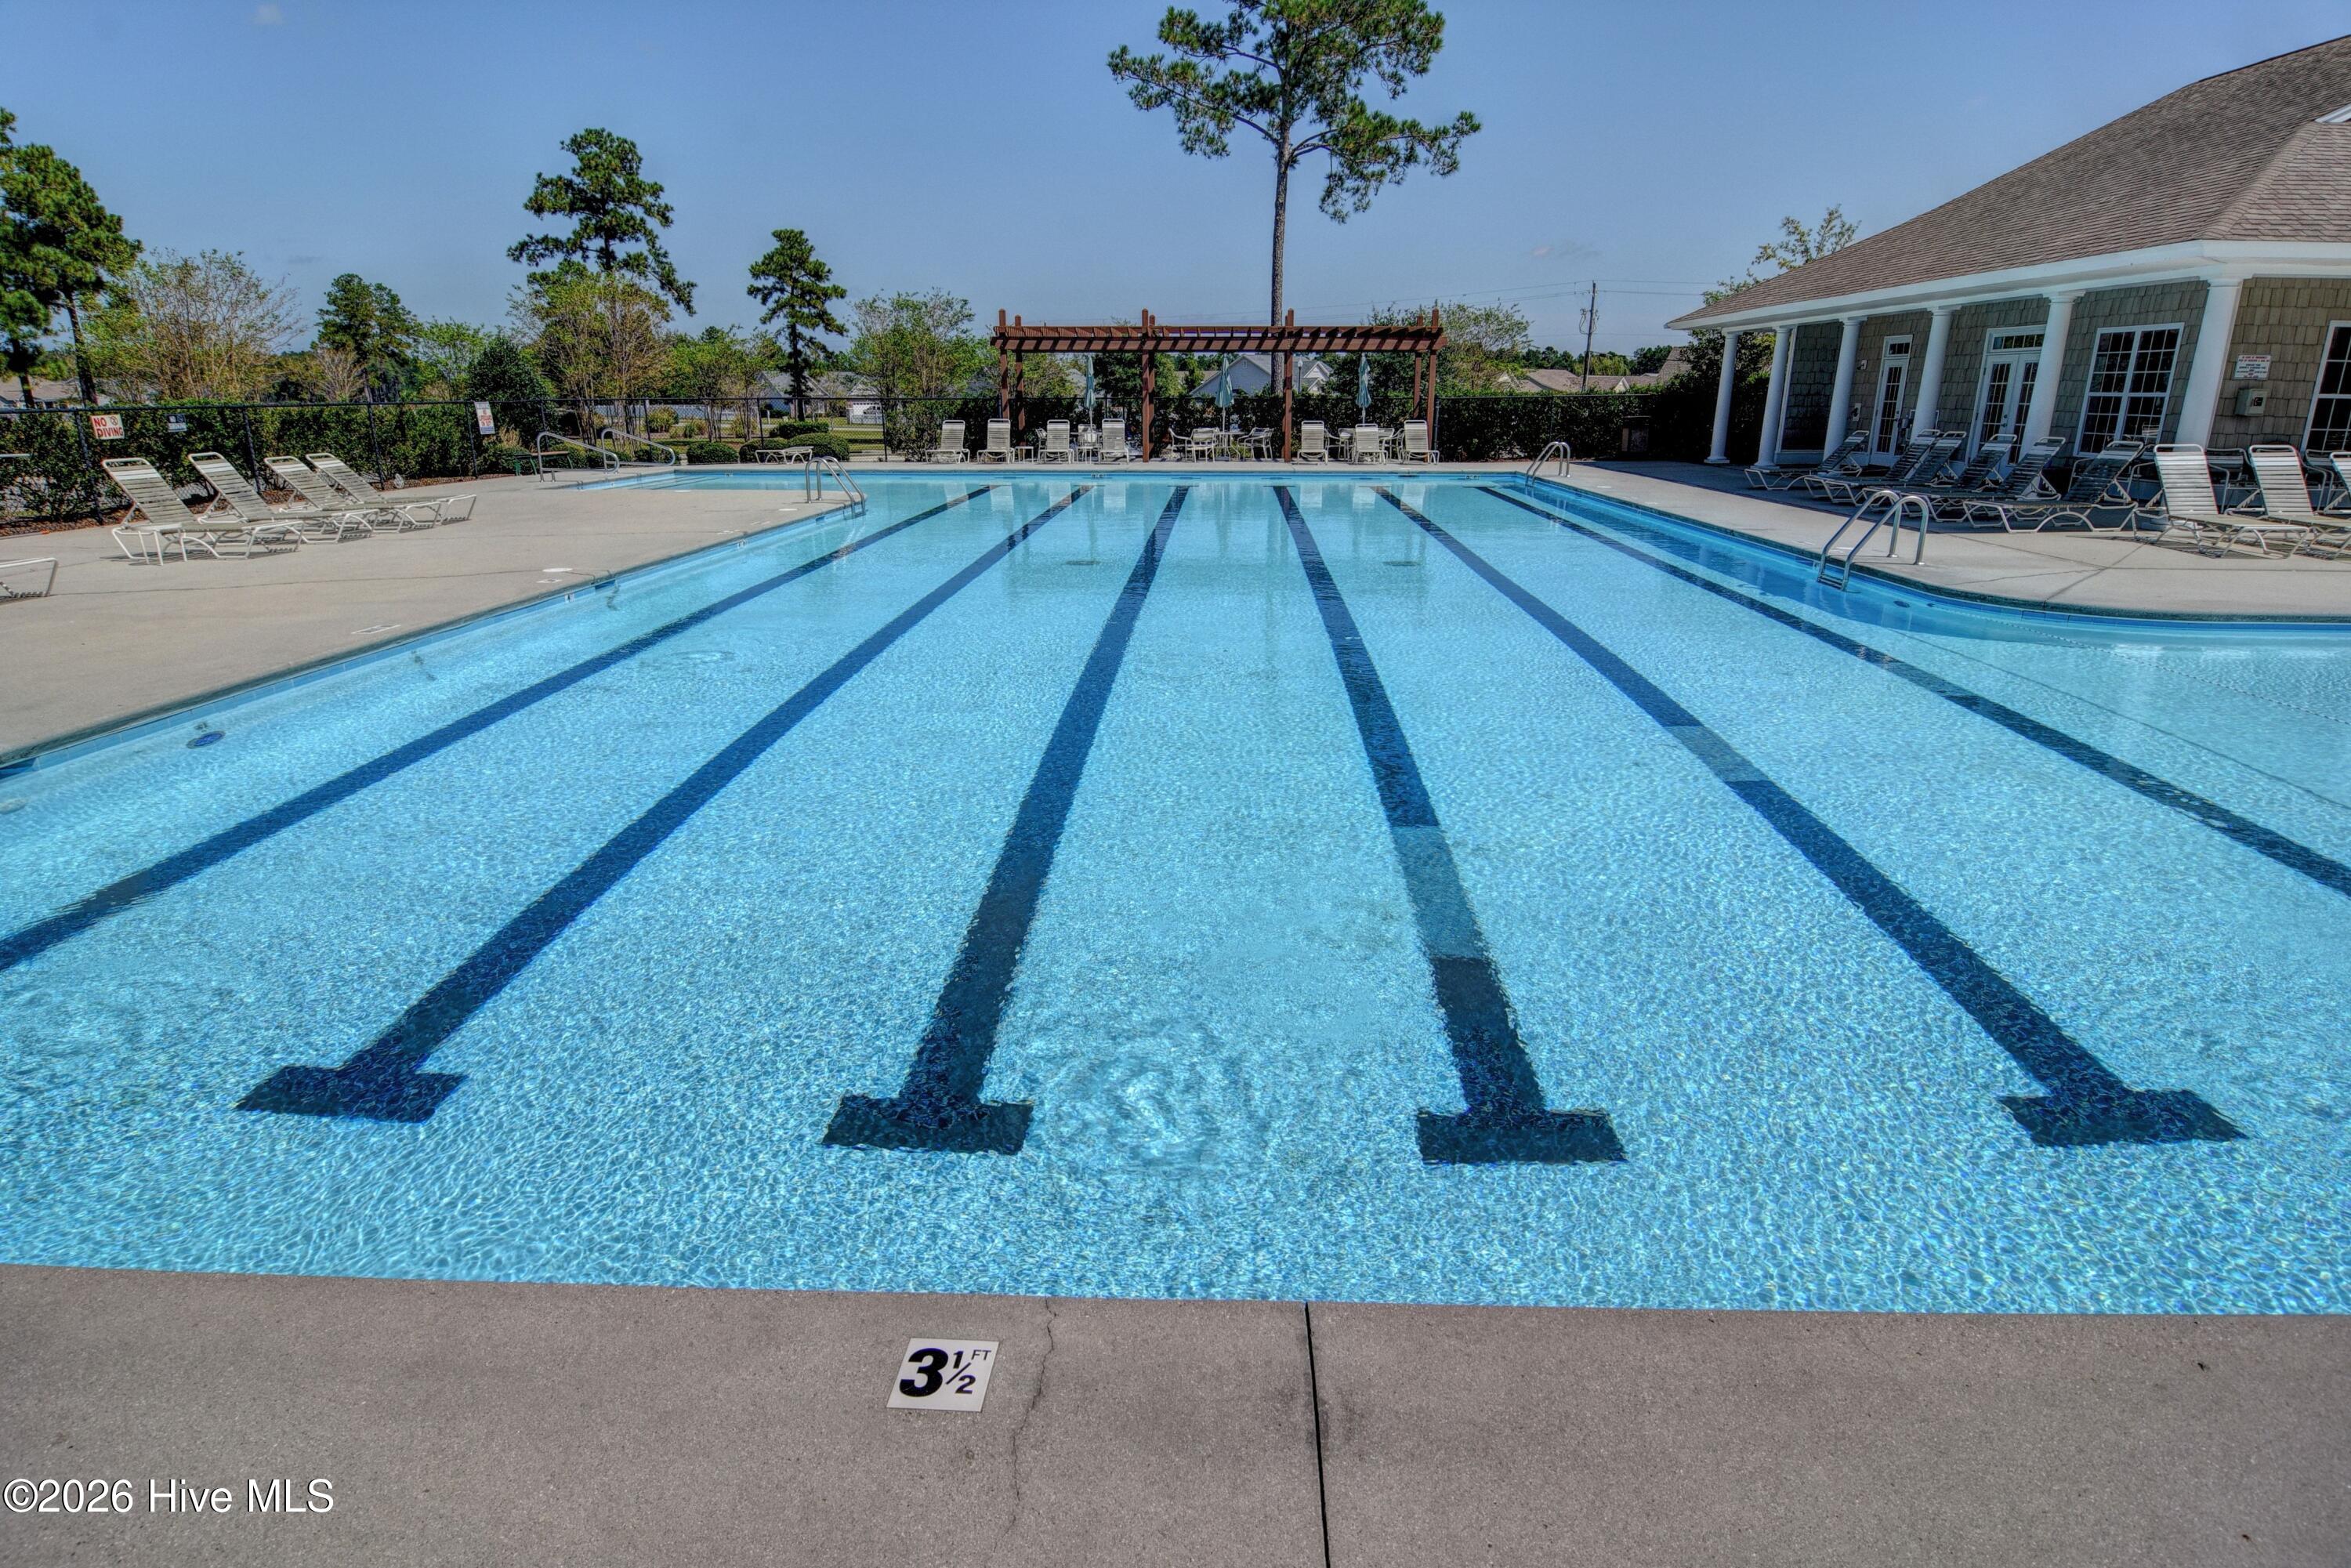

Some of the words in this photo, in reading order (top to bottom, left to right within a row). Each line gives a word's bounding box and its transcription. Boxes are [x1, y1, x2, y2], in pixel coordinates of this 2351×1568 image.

[93, 418, 107, 426] NO
[96, 428, 124, 437] DIVING
[971, 1349, 992, 1361] FT
